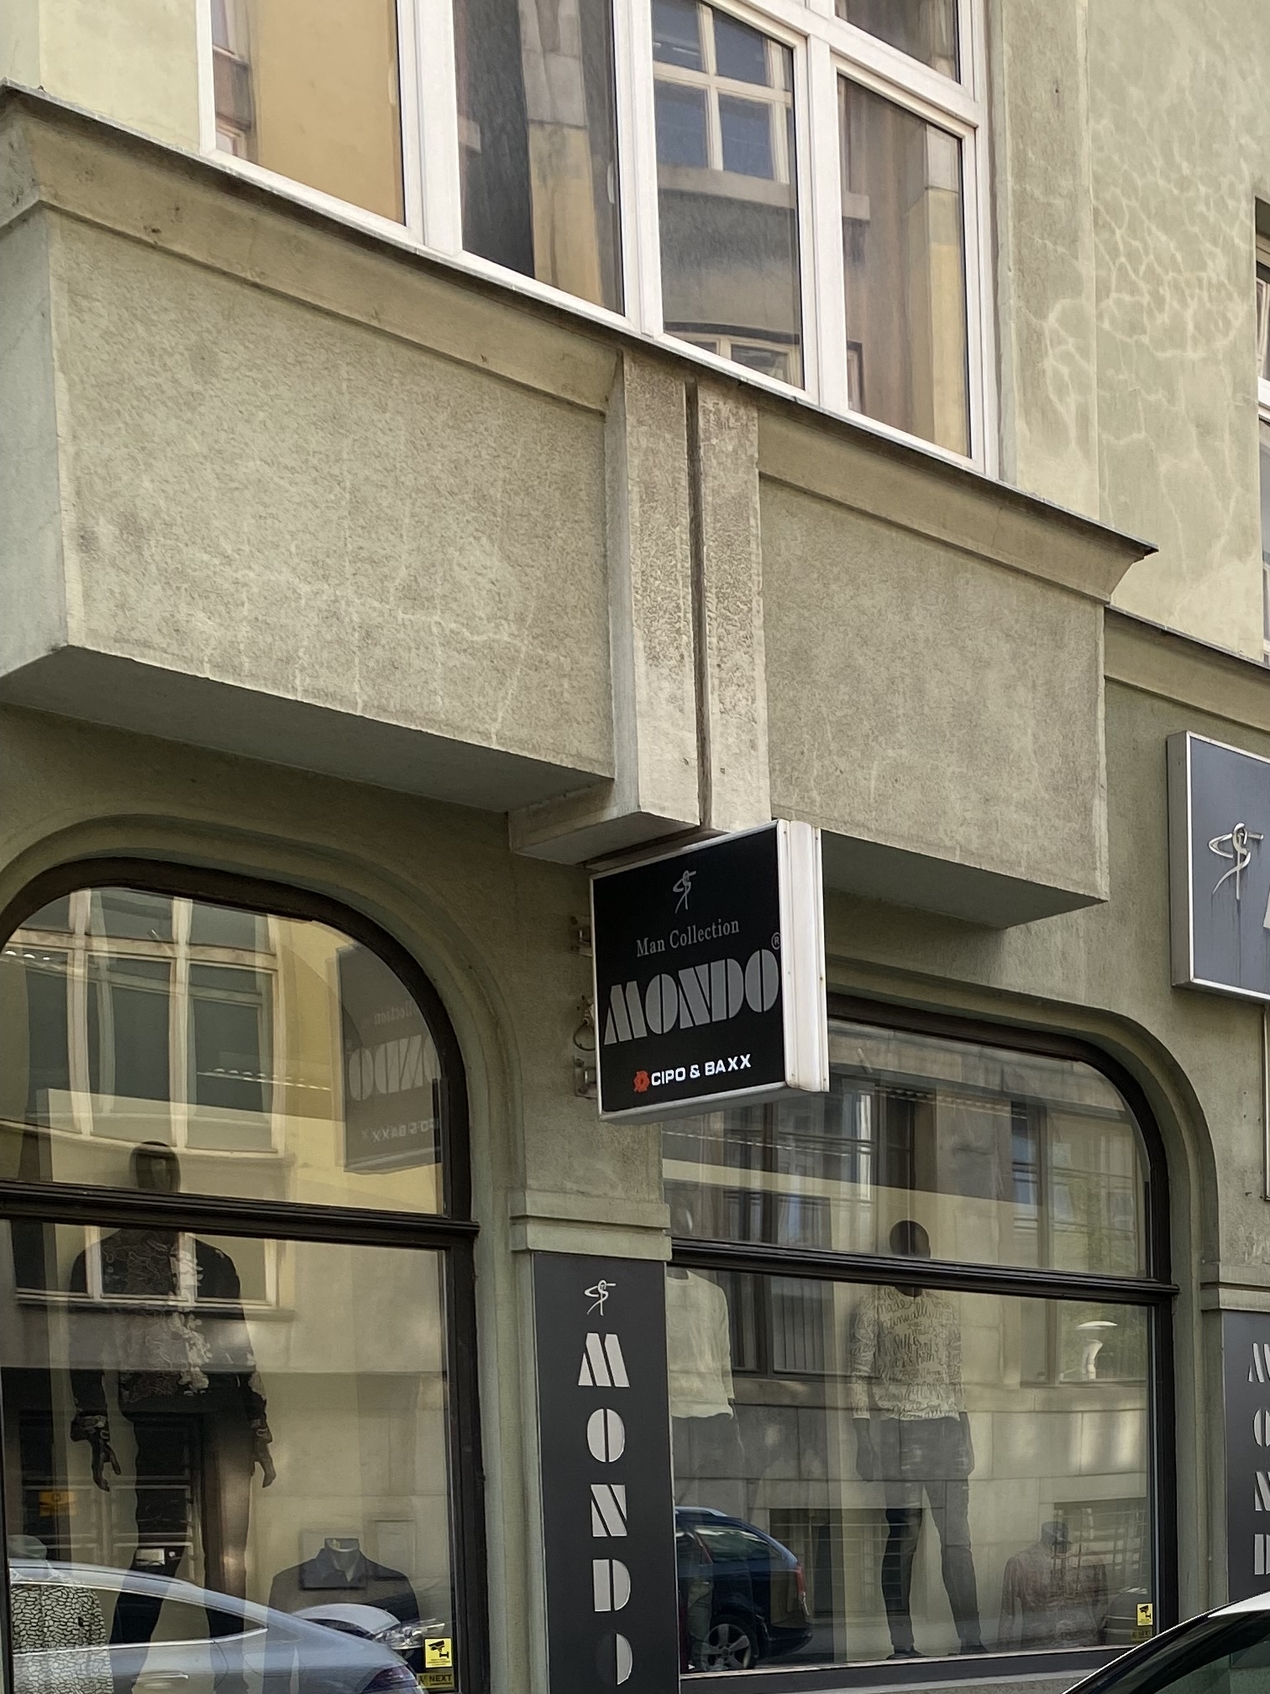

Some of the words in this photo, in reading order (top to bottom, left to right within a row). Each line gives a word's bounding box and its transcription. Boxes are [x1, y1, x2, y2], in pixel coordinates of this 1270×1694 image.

[636, 938, 665, 957] Man
[670, 917, 740, 948] Collection
[604, 948, 780, 1046] MONDO
[651, 1067, 687, 1087] CIPO
[689, 1064, 701, 1079] &
[705, 1053, 752, 1078] BAXX
